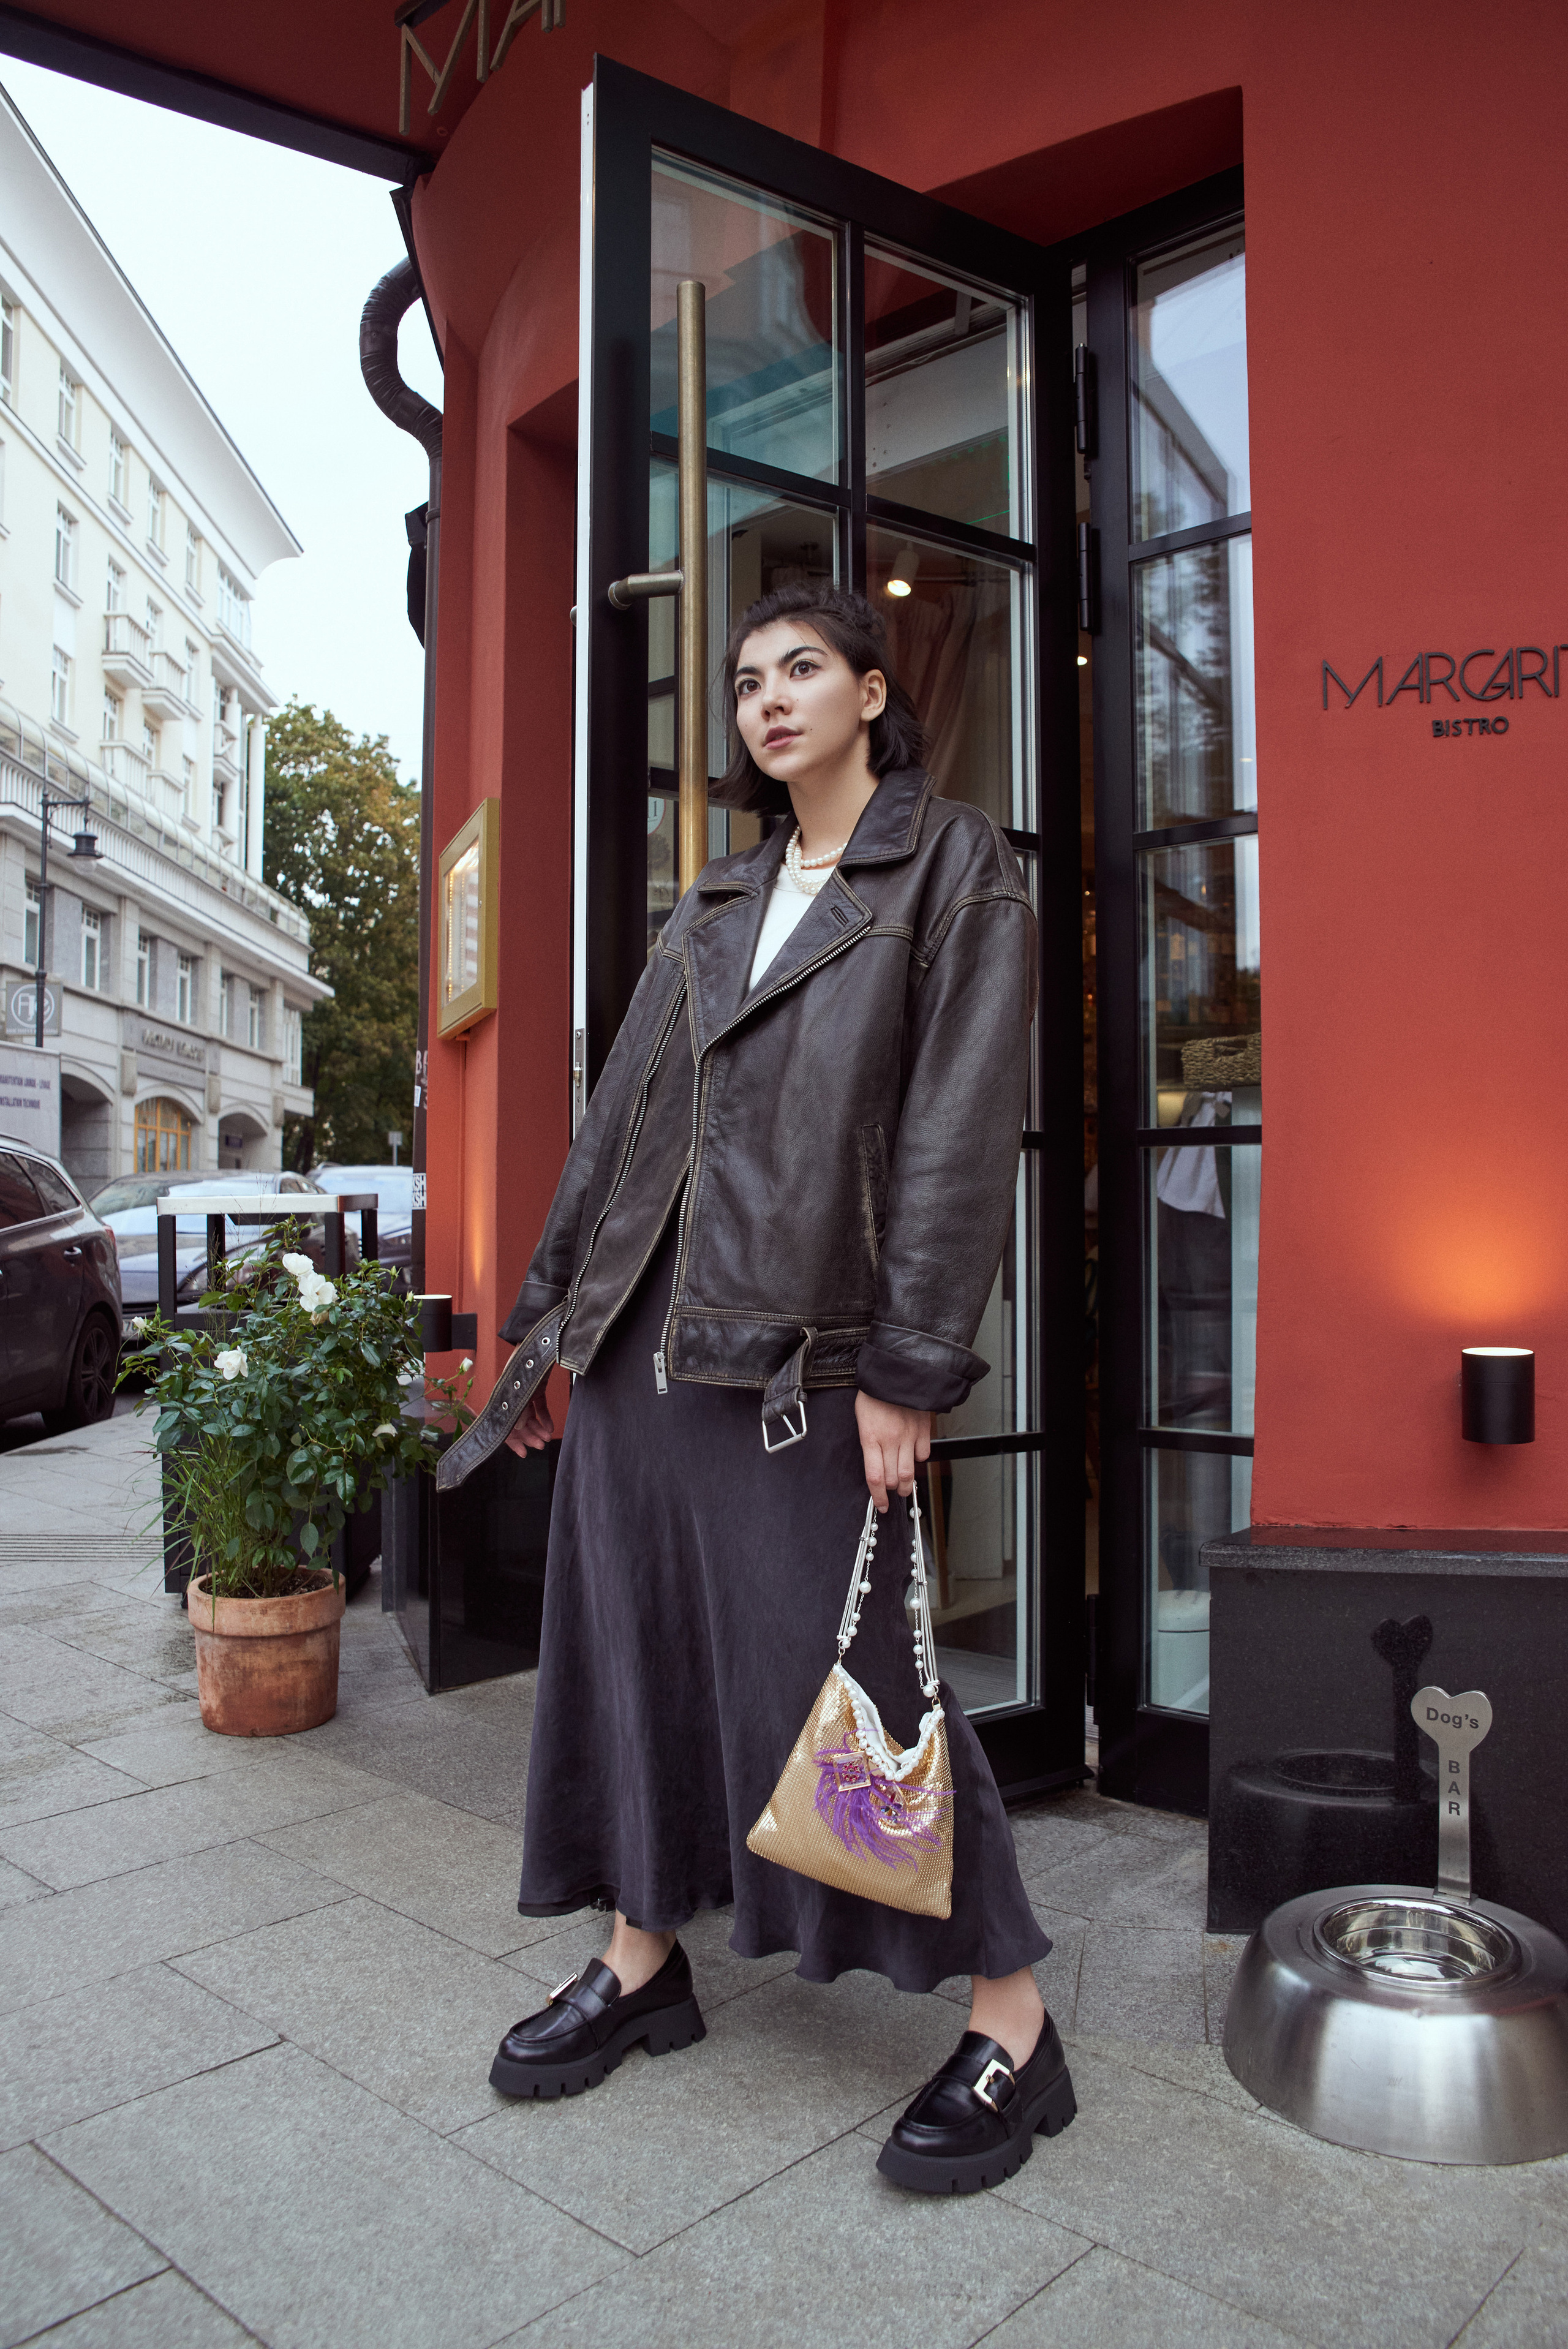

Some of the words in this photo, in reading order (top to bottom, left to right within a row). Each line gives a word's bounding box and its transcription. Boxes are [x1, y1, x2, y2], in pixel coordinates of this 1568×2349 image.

[1322, 643, 1568, 710] MARGARI
[1432, 716, 1509, 737] BISTRO
[1426, 1706, 1479, 1729] Dog's
[1448, 1760, 1461, 1816] BAR
